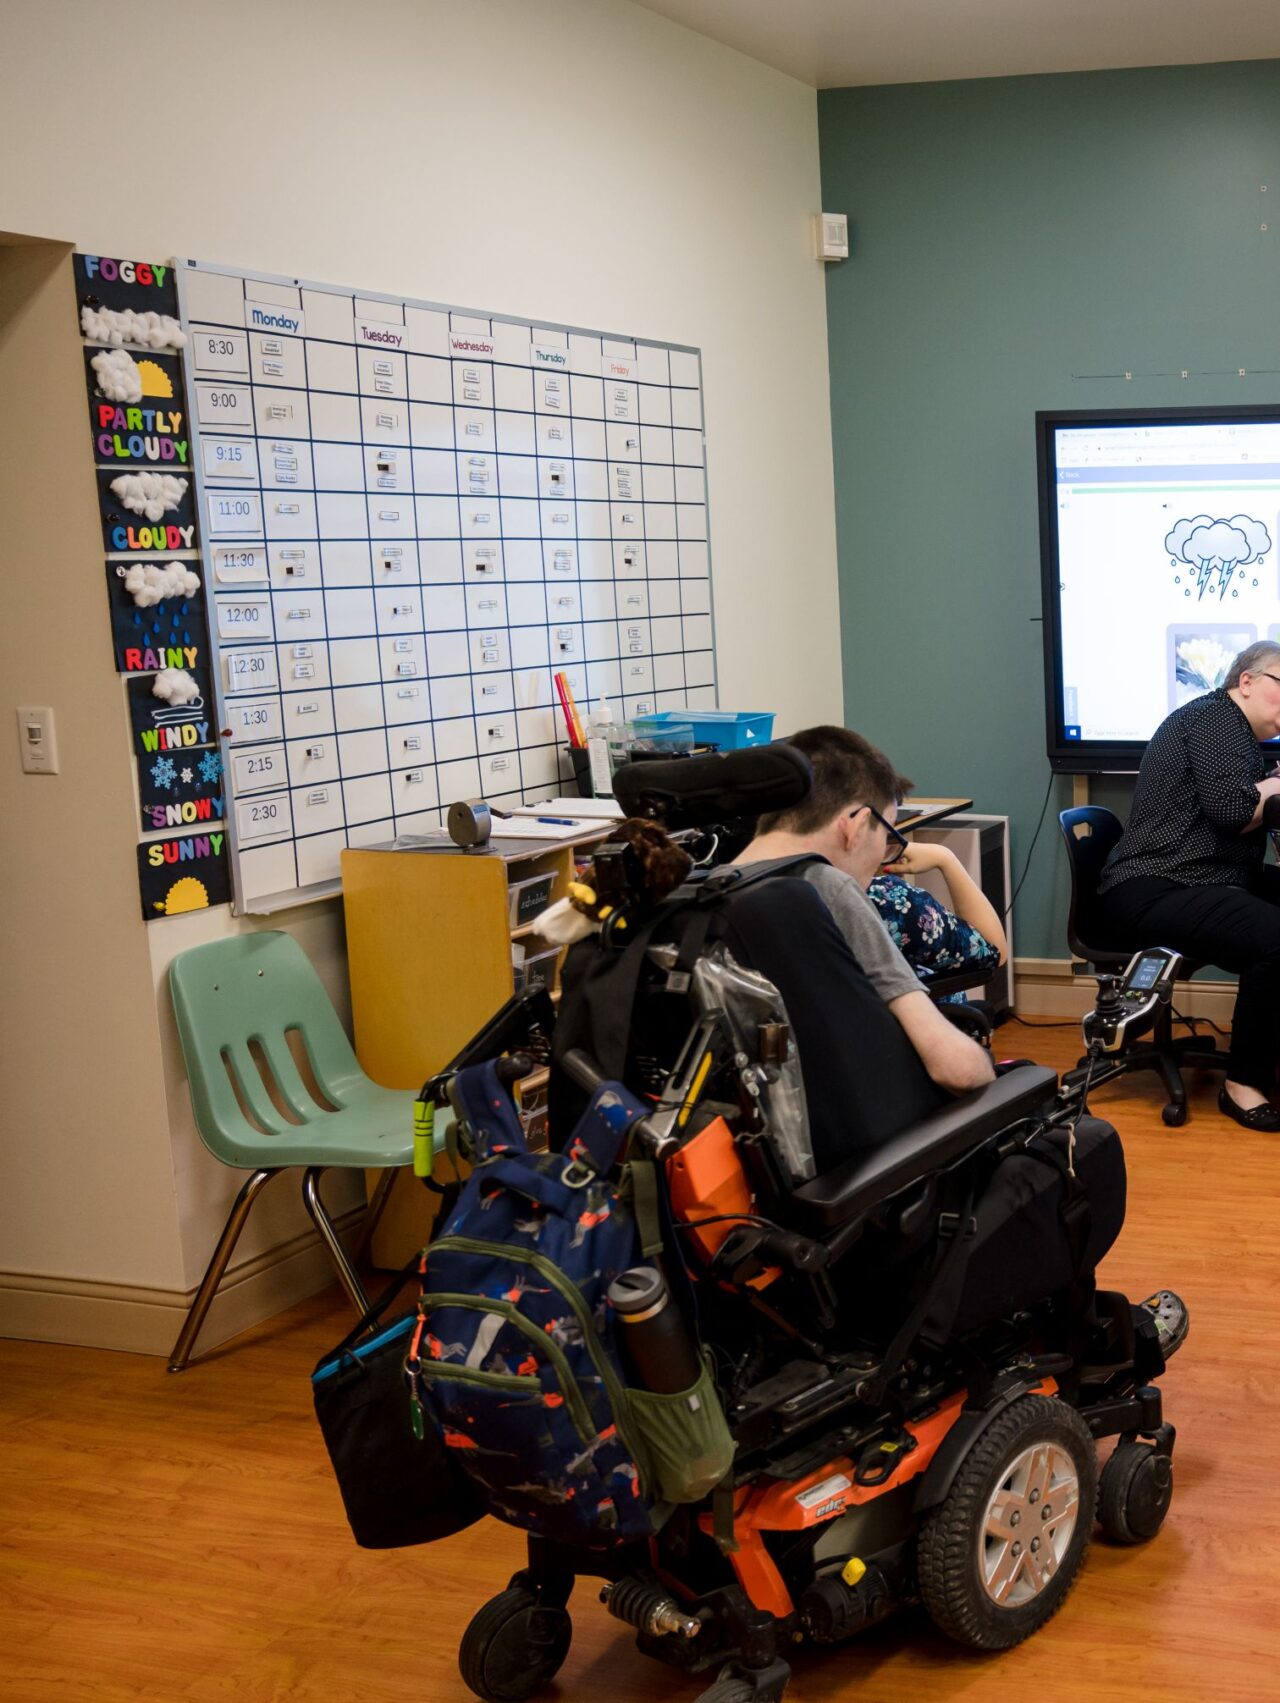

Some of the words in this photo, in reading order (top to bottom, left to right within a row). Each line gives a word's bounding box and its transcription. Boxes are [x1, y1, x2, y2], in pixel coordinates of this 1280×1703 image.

[84, 255, 166, 288] FOGGY
[252, 309, 299, 333] Monday
[361, 327, 402, 348] Tuesday
[208, 340, 234, 355] 8:30
[451, 338, 493, 355] Wednesday
[535, 351, 566, 364] Thursday
[610, 364, 630, 376] Friday
[211, 394, 237, 408] 9:00
[98, 404, 182, 434] PARTLY
[98, 434, 187, 463] CLOUDY
[216, 447, 242, 462] 9:15
[218, 501, 250, 516] 11:00
[112, 525, 195, 549] CLOUDY
[223, 553, 254, 568] 11:30
[227, 608, 259, 623] 12:00
[126, 648, 197, 671] RAINY
[233, 657, 265, 674] 12:30
[243, 709, 268, 725] 1:30
[141, 721, 209, 752] WINDY
[248, 756, 273, 773] 2:15
[152, 797, 223, 827] SNOWY
[252, 804, 277, 821] 2:30
[149, 833, 223, 866] SUNNY
